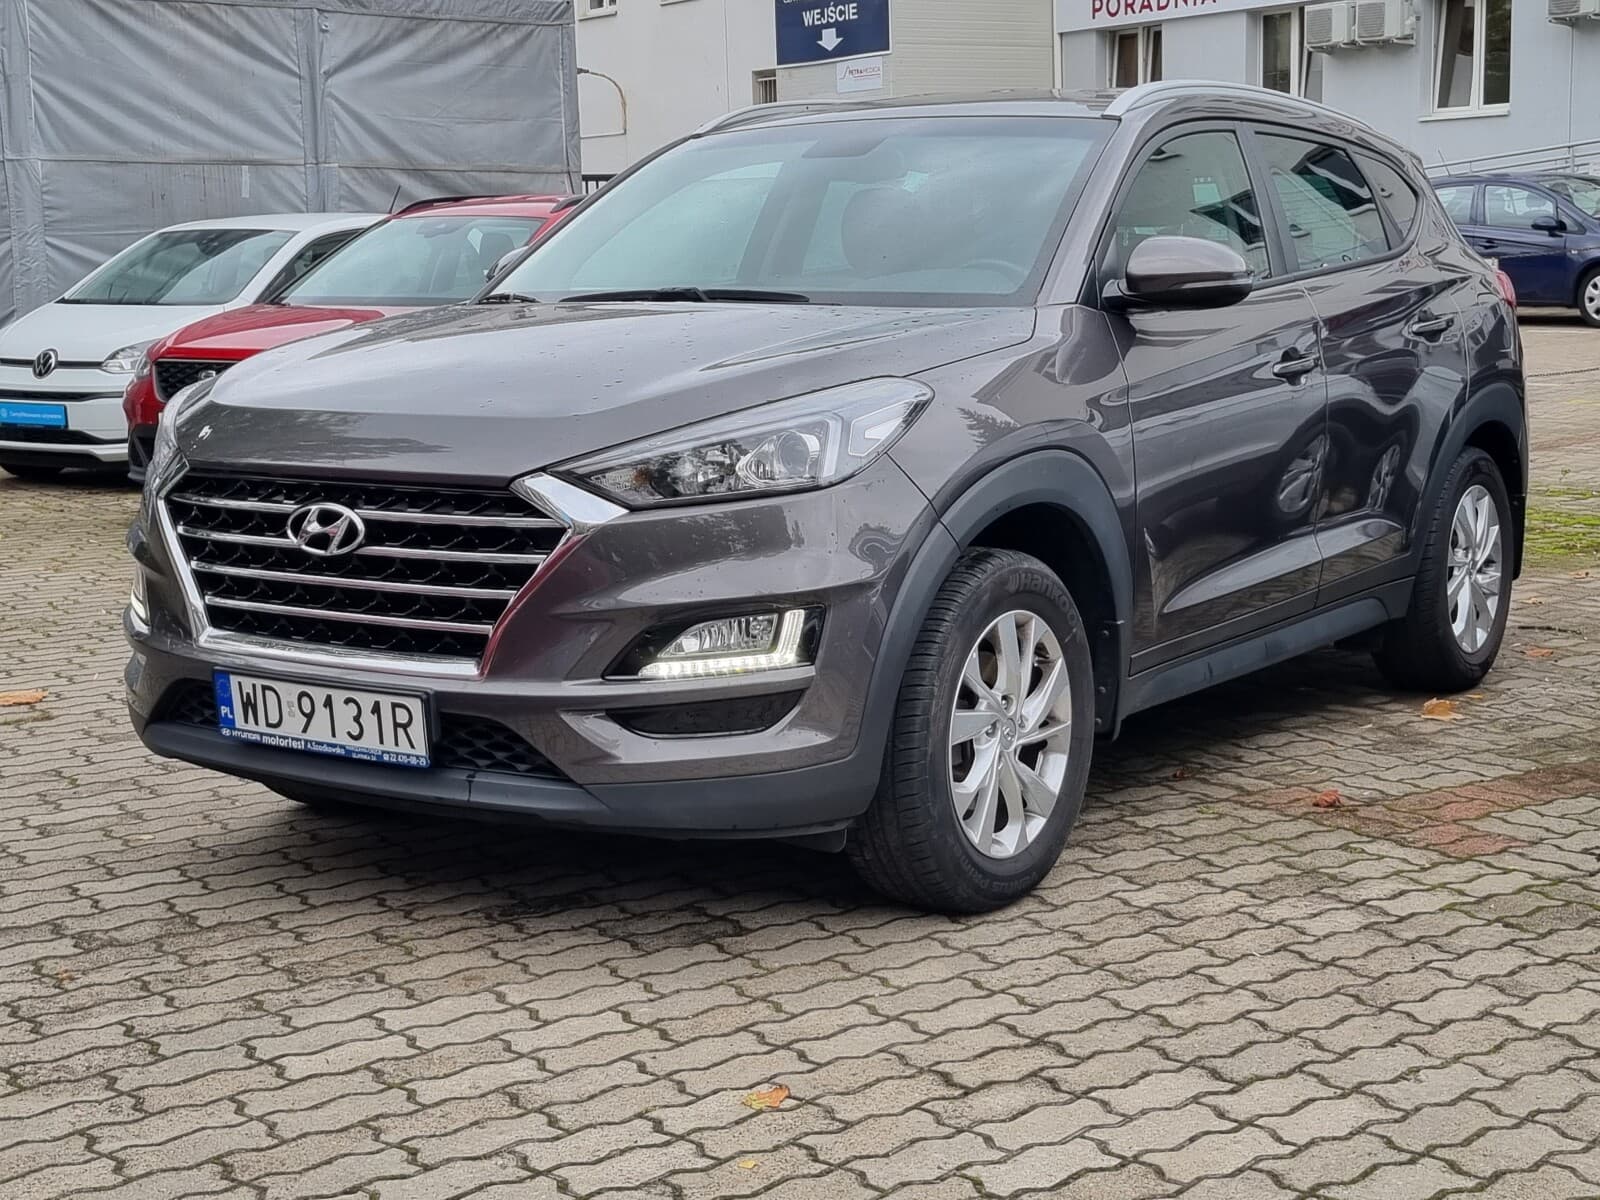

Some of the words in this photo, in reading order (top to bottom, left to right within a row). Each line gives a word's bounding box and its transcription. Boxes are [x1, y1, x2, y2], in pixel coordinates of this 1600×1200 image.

[802, 2, 858, 27] WEJŚCIE
[1092, 0, 1217, 20] PORAD
[220, 705, 234, 719] PL
[237, 680, 284, 729] WD
[296, 690, 416, 750] 9131R
[231, 729, 261, 742] HYUNDAI
